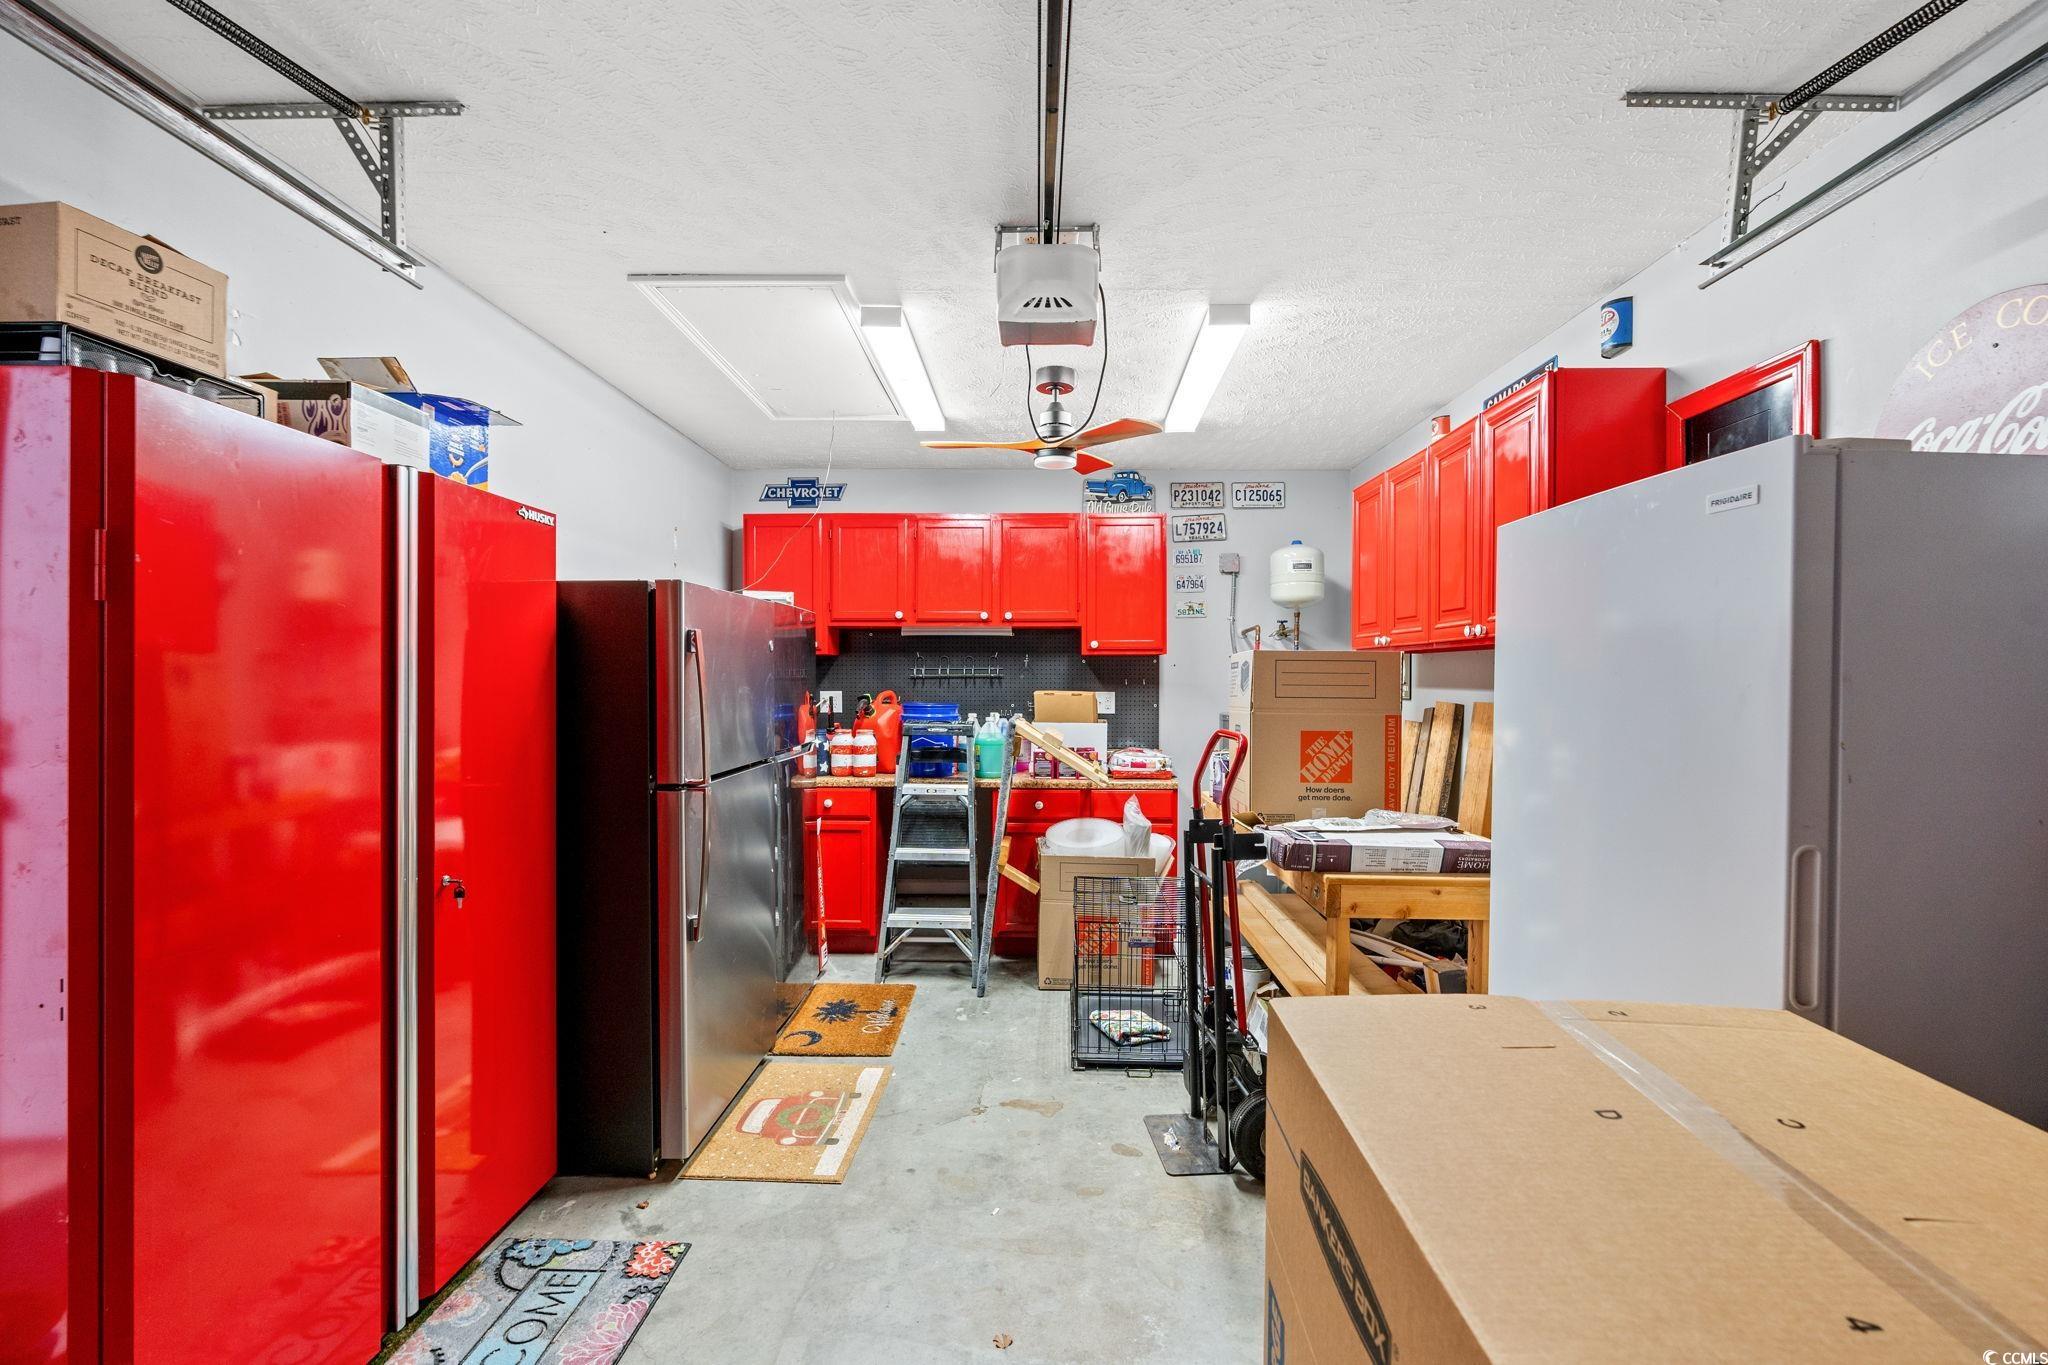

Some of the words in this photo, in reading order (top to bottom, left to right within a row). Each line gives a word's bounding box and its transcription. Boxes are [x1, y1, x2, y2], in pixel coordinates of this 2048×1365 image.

[90, 253, 132, 278] DECAF
[136, 272, 201, 305] BREAKFAST
[128, 278, 168, 301] BLEND
[1911, 322, 1972, 382] ICE
[767, 487, 841, 498] CHEVROLET
[1174, 489, 1222, 502] P231042
[1235, 489, 1282, 502] C125065
[1710, 491, 1753, 508] FRIGIDAIRE
[528, 510, 555, 527] HUSKY
[1175, 521, 1223, 537] L757924
[1175, 554, 1203, 565] 695187
[1176, 579, 1204, 590] 647964
[1304, 735, 1328, 758] THE
[1387, 718, 1396, 762] MEDIUM
[1300, 730, 1353, 783] HOME
[1320, 748, 1353, 783] DEPOT
[1388, 766, 1396, 790] DUTY
[1306, 786, 1322, 794] How
[1323, 786, 1345, 794] doers
[1298, 795, 1310, 803] get
[1303, 1170, 1355, 1292] BANKERS
[1354, 1278, 1386, 1365] BOX
[1845, 1316, 1884, 1334] 4
